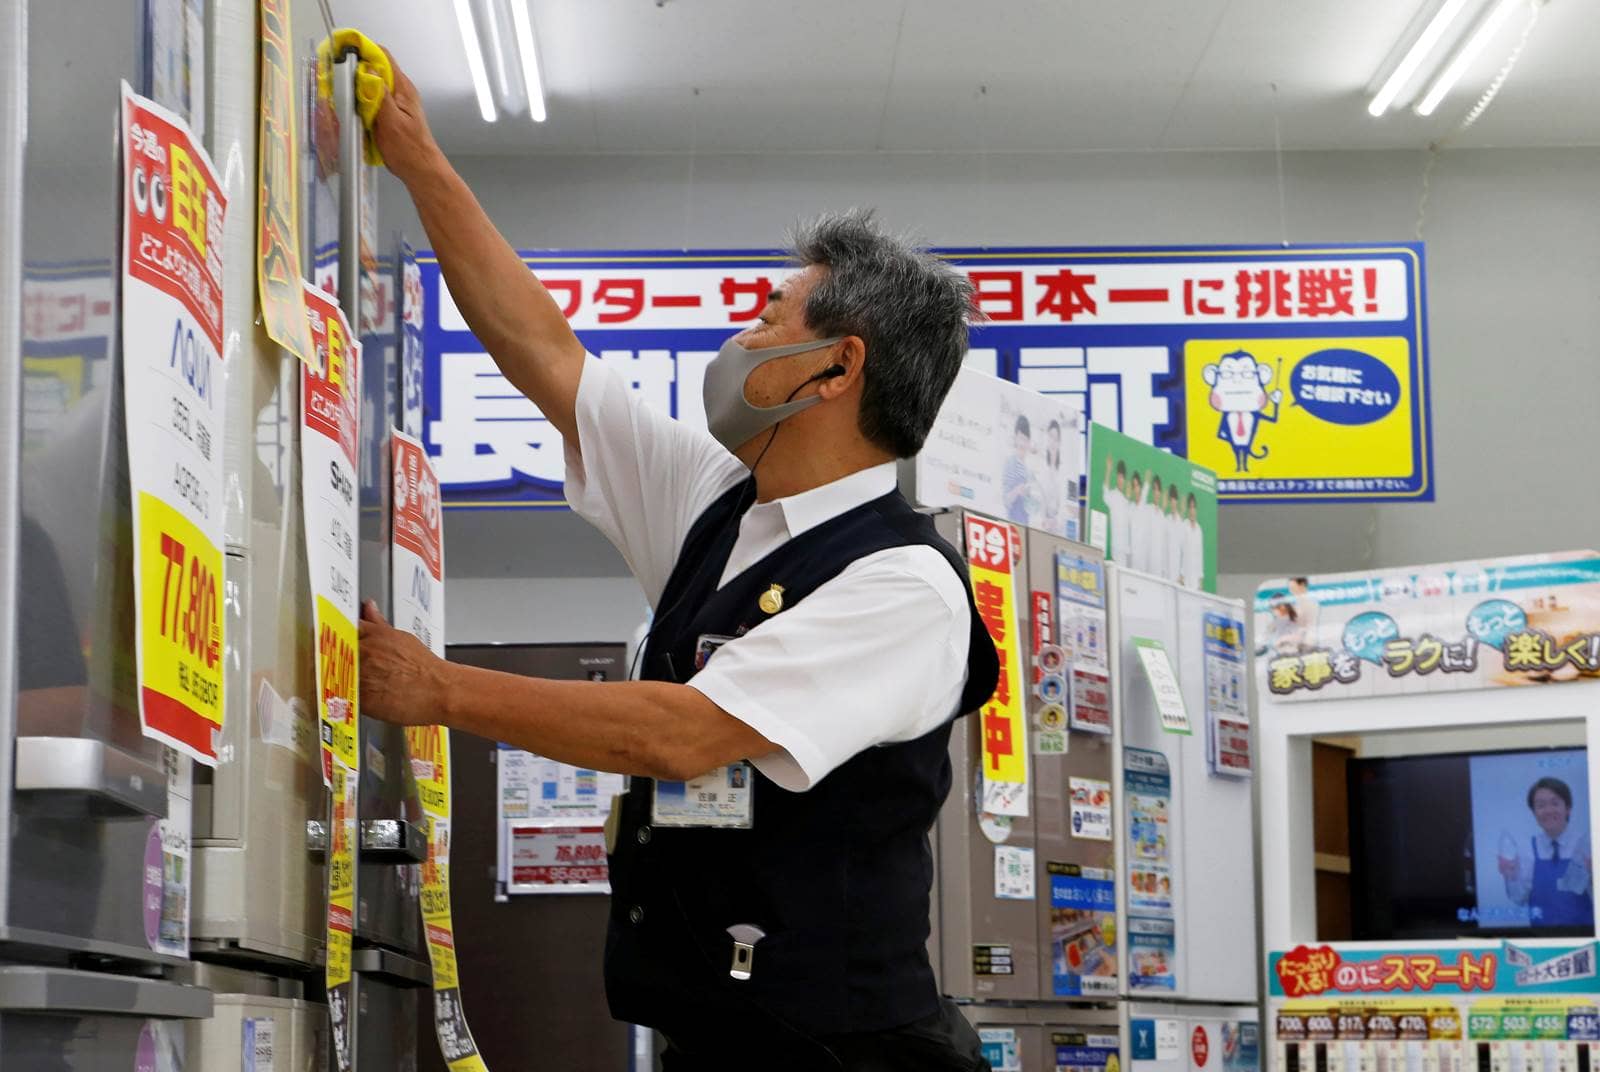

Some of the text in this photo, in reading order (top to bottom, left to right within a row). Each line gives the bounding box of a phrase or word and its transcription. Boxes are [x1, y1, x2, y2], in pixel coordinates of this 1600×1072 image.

[968, 522, 1007, 566] 只今
[1507, 630, 1600, 669] 楽しく!
[1279, 951, 1335, 977] たっぷり
[1337, 955, 1491, 986] のにスマート!
[1294, 971, 1330, 994] 入る!
